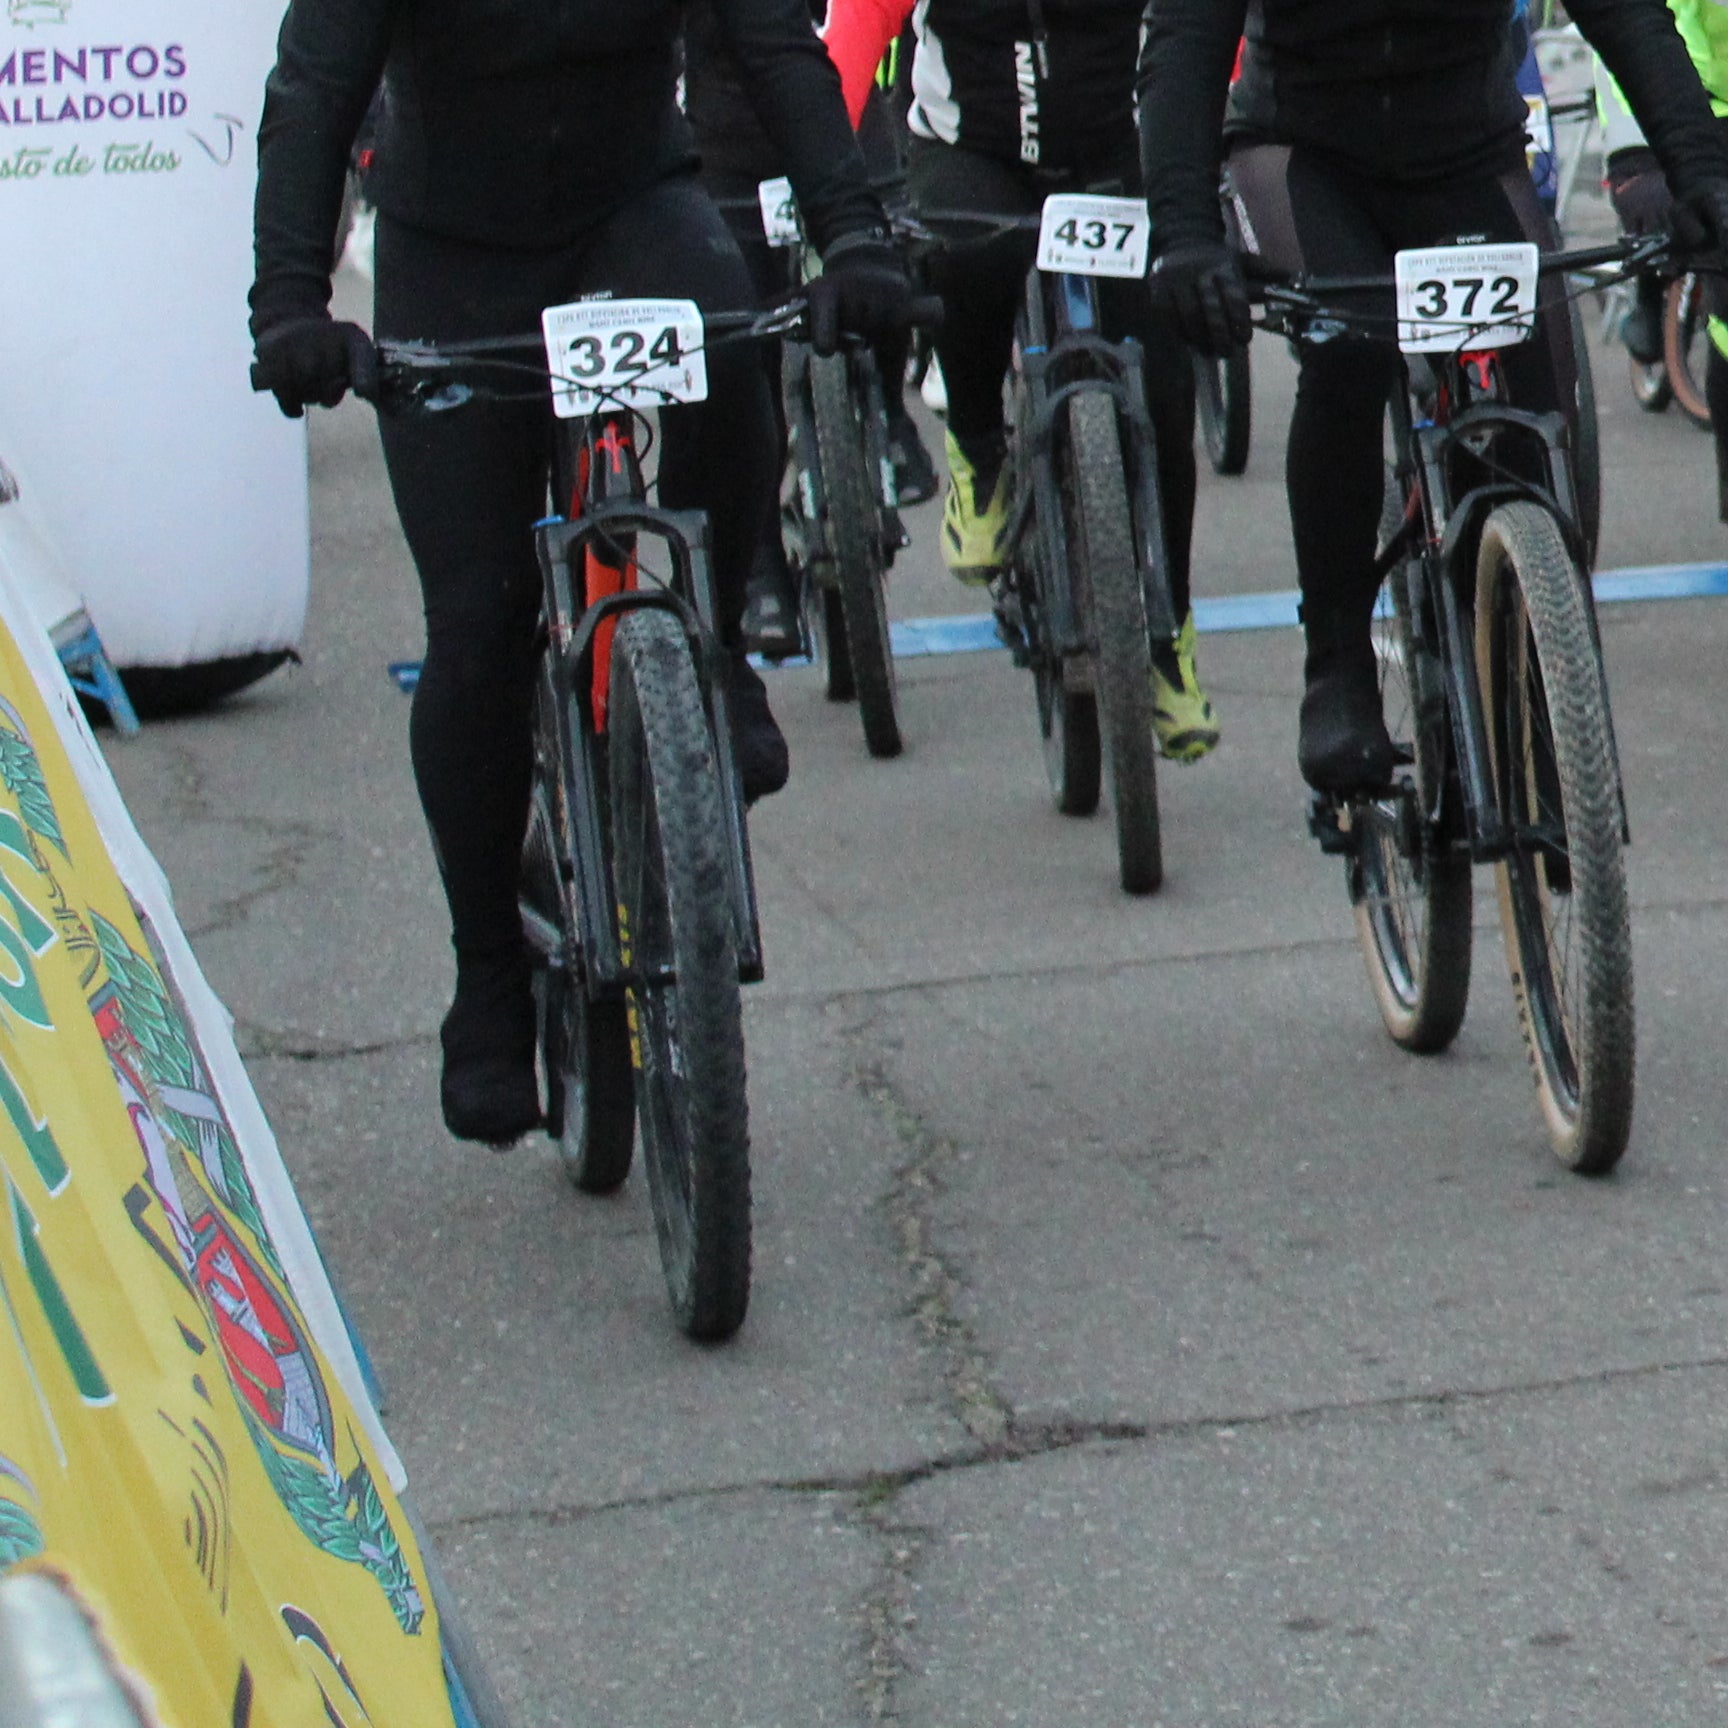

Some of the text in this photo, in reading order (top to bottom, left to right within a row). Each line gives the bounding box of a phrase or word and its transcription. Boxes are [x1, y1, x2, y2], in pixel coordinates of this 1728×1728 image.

[104, 141, 181, 174] todos
[1054, 218, 1135, 252] 437
[1416, 277, 1519, 318] 372
[569, 326, 683, 378] 324
